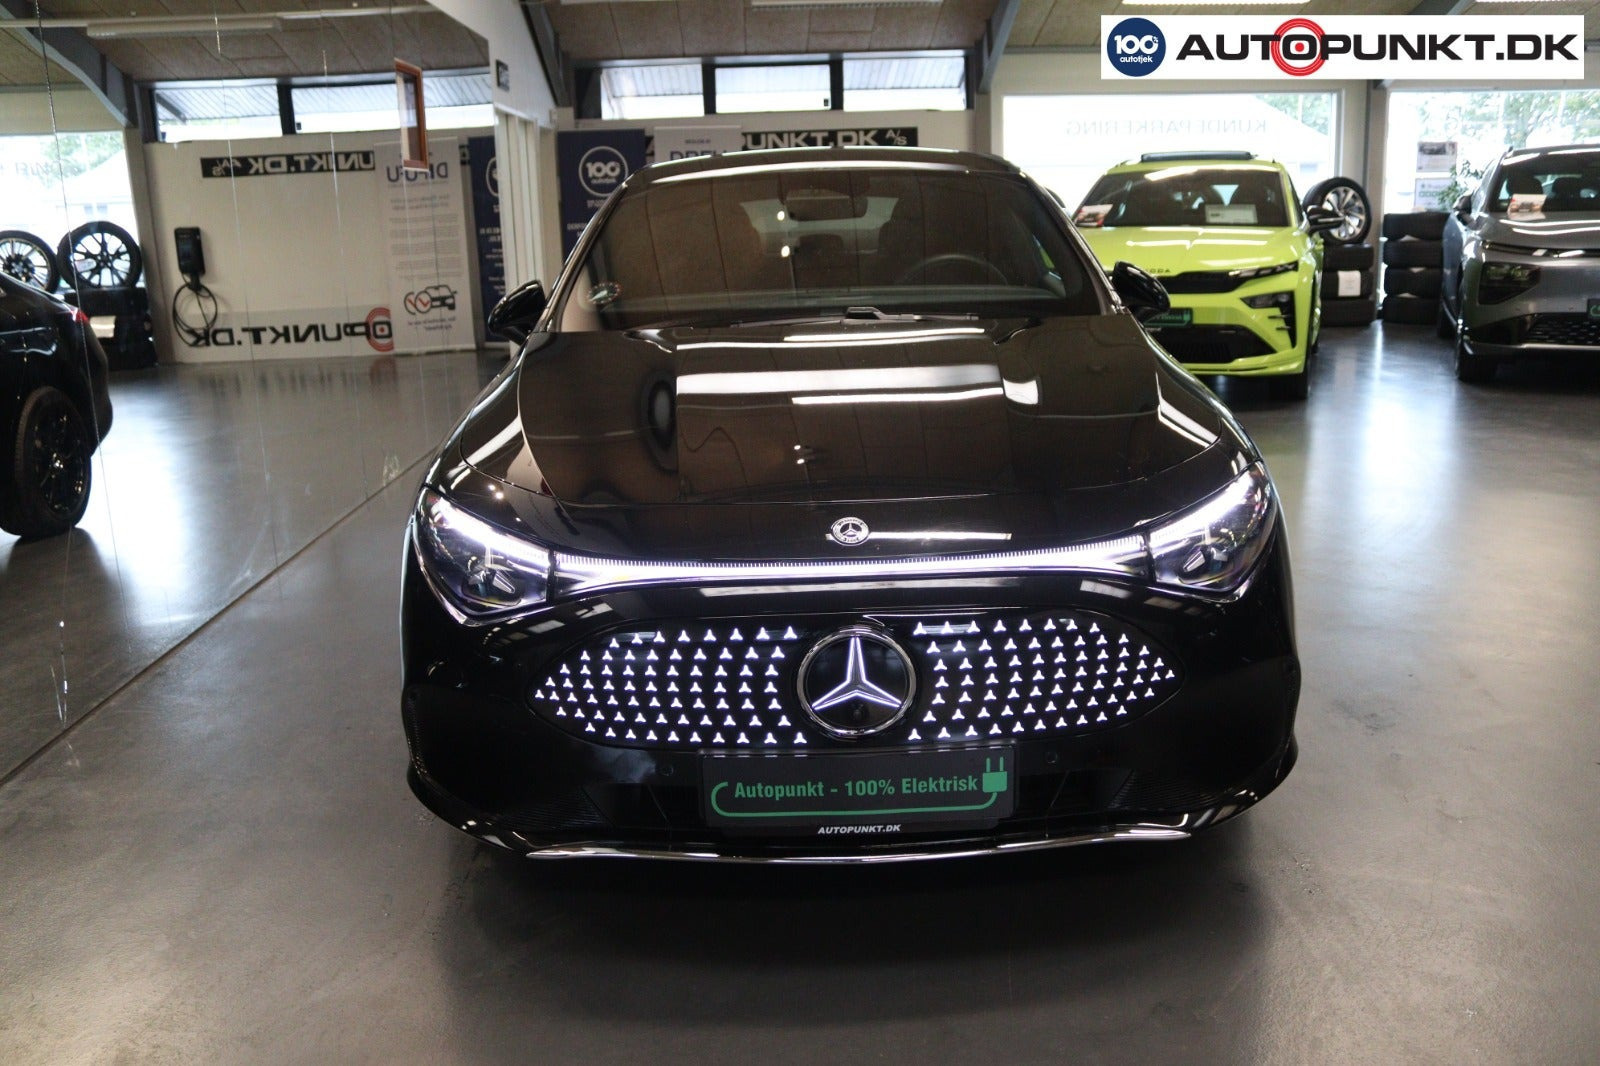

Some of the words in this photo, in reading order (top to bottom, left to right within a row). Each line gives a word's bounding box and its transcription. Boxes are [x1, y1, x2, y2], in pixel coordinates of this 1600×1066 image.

[885, 128, 908, 146] A/S
[734, 781, 824, 801] Autopunkt
[844, 779, 895, 797] 100%
[901, 775, 979, 795] Elektrisk
[817, 824, 901, 836] AUTOPUNKT.DK
